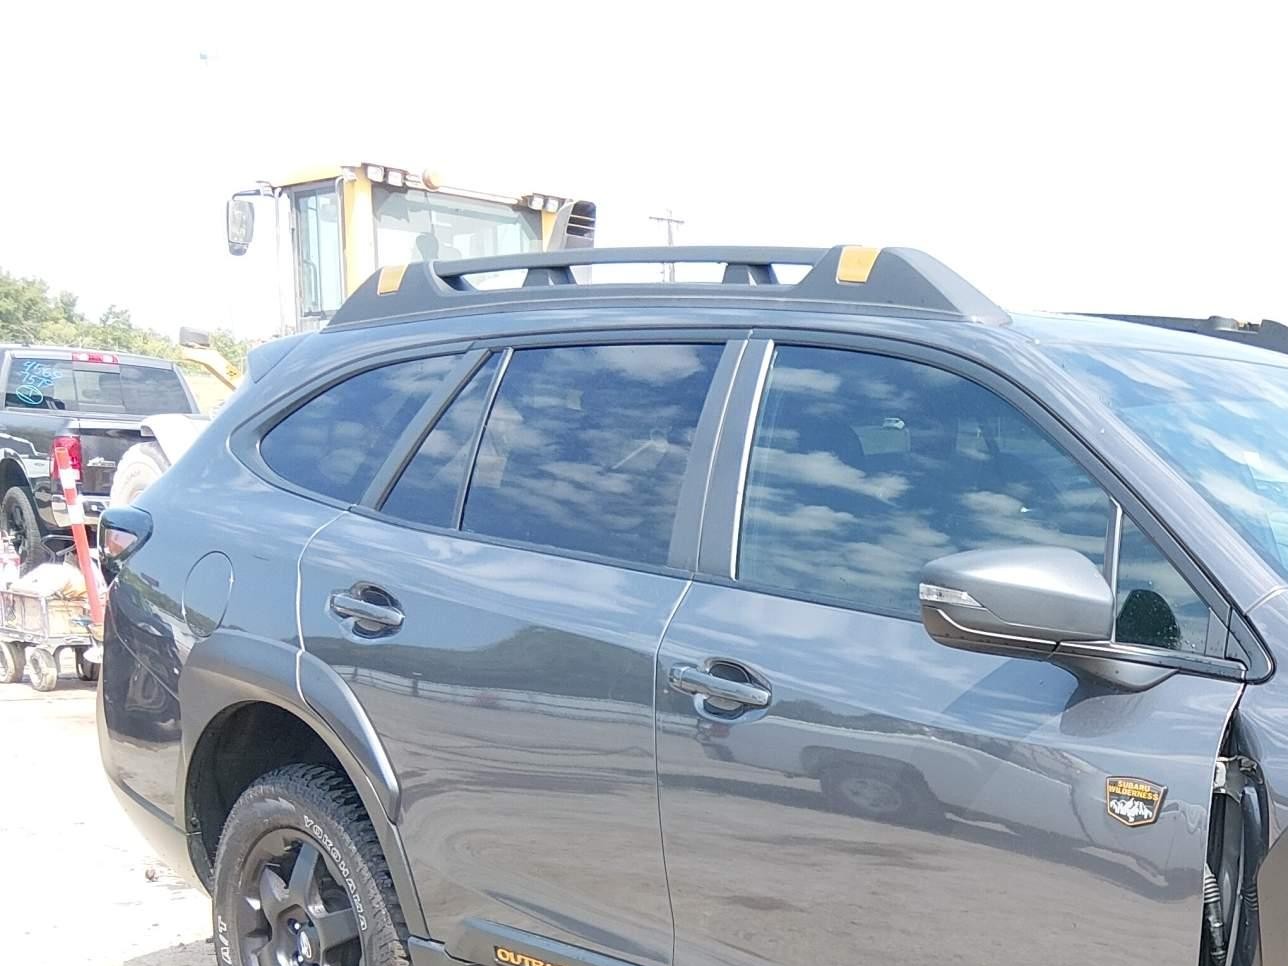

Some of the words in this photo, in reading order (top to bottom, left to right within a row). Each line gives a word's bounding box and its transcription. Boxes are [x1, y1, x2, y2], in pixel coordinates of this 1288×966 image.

[1108, 785, 1159, 801] WILDERNESS
[1117, 781, 1151, 792] SUBARU
[303, 815, 367, 931] YOKOHAMA
[217, 914, 233, 965] A/T
